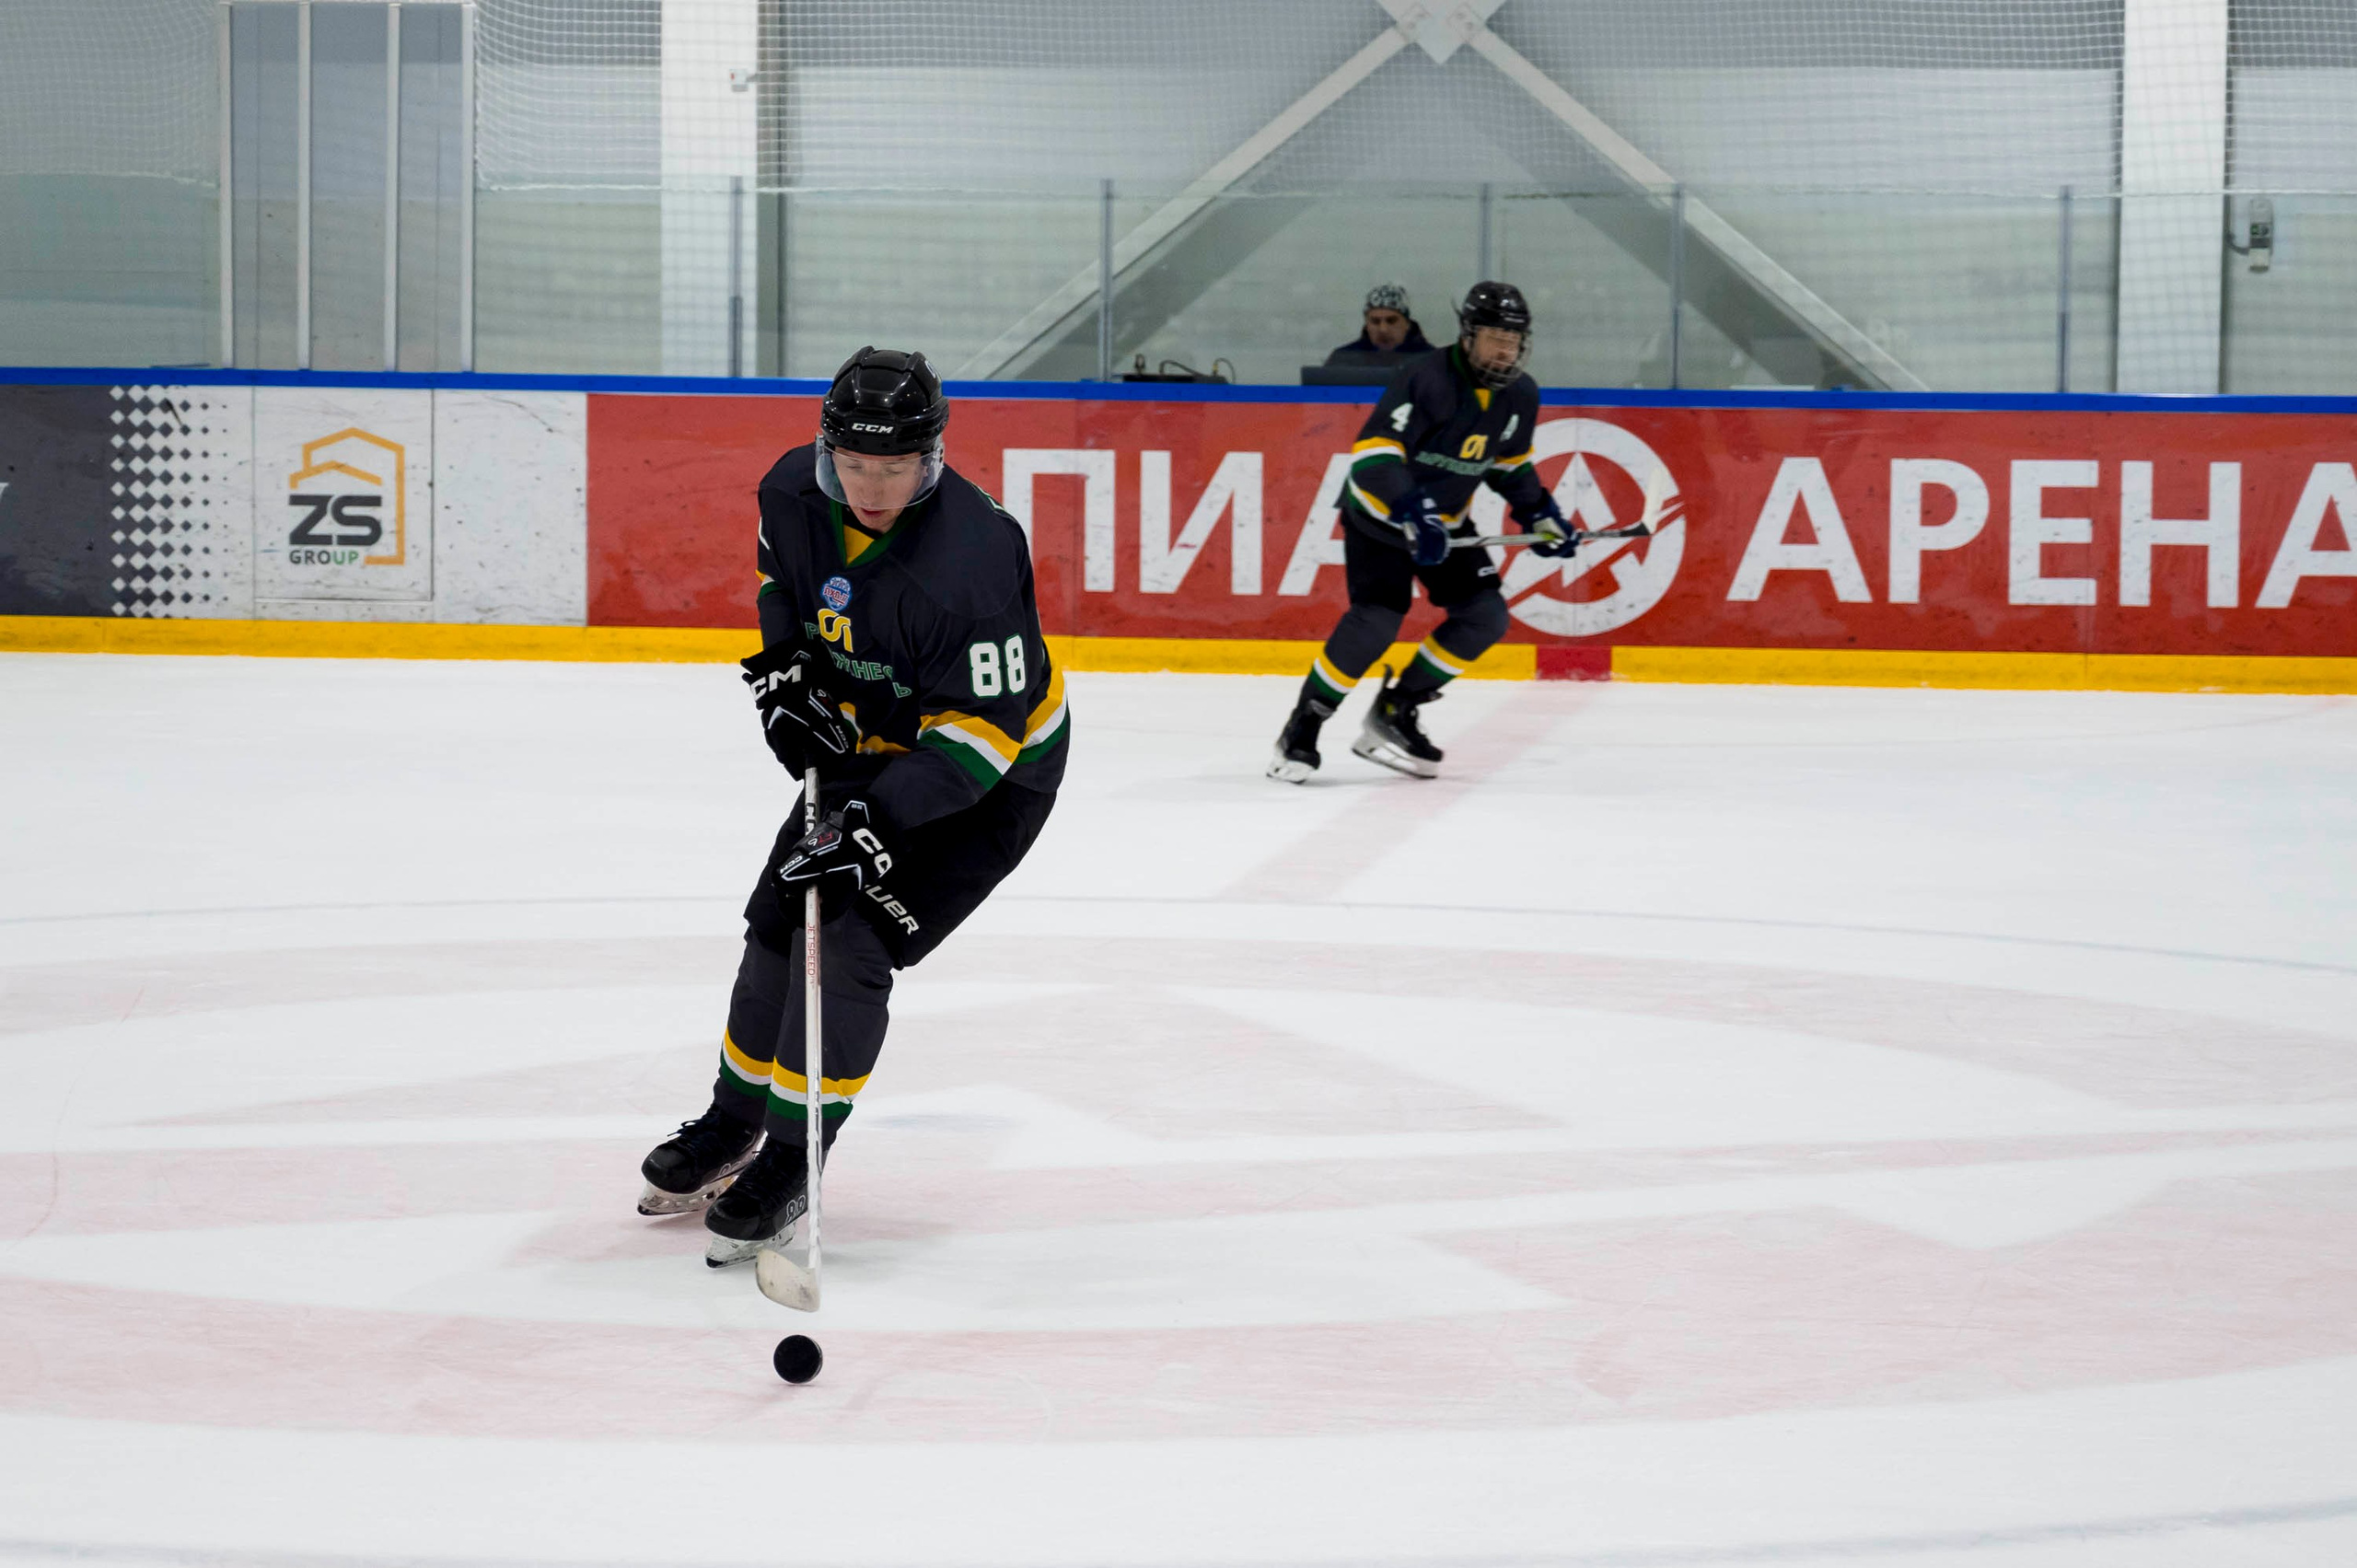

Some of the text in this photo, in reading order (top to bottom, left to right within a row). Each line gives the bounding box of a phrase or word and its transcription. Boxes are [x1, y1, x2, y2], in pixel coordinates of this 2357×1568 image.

[852, 423, 894, 434] CCM
[1390, 402, 1414, 433] 4
[289, 494, 382, 546] ZS
[1726, 457, 2357, 609] АРЕНА
[289, 550, 359, 565] GROUP
[969, 634, 1026, 697] 88
[807, 923, 816, 976] JETSPEED
